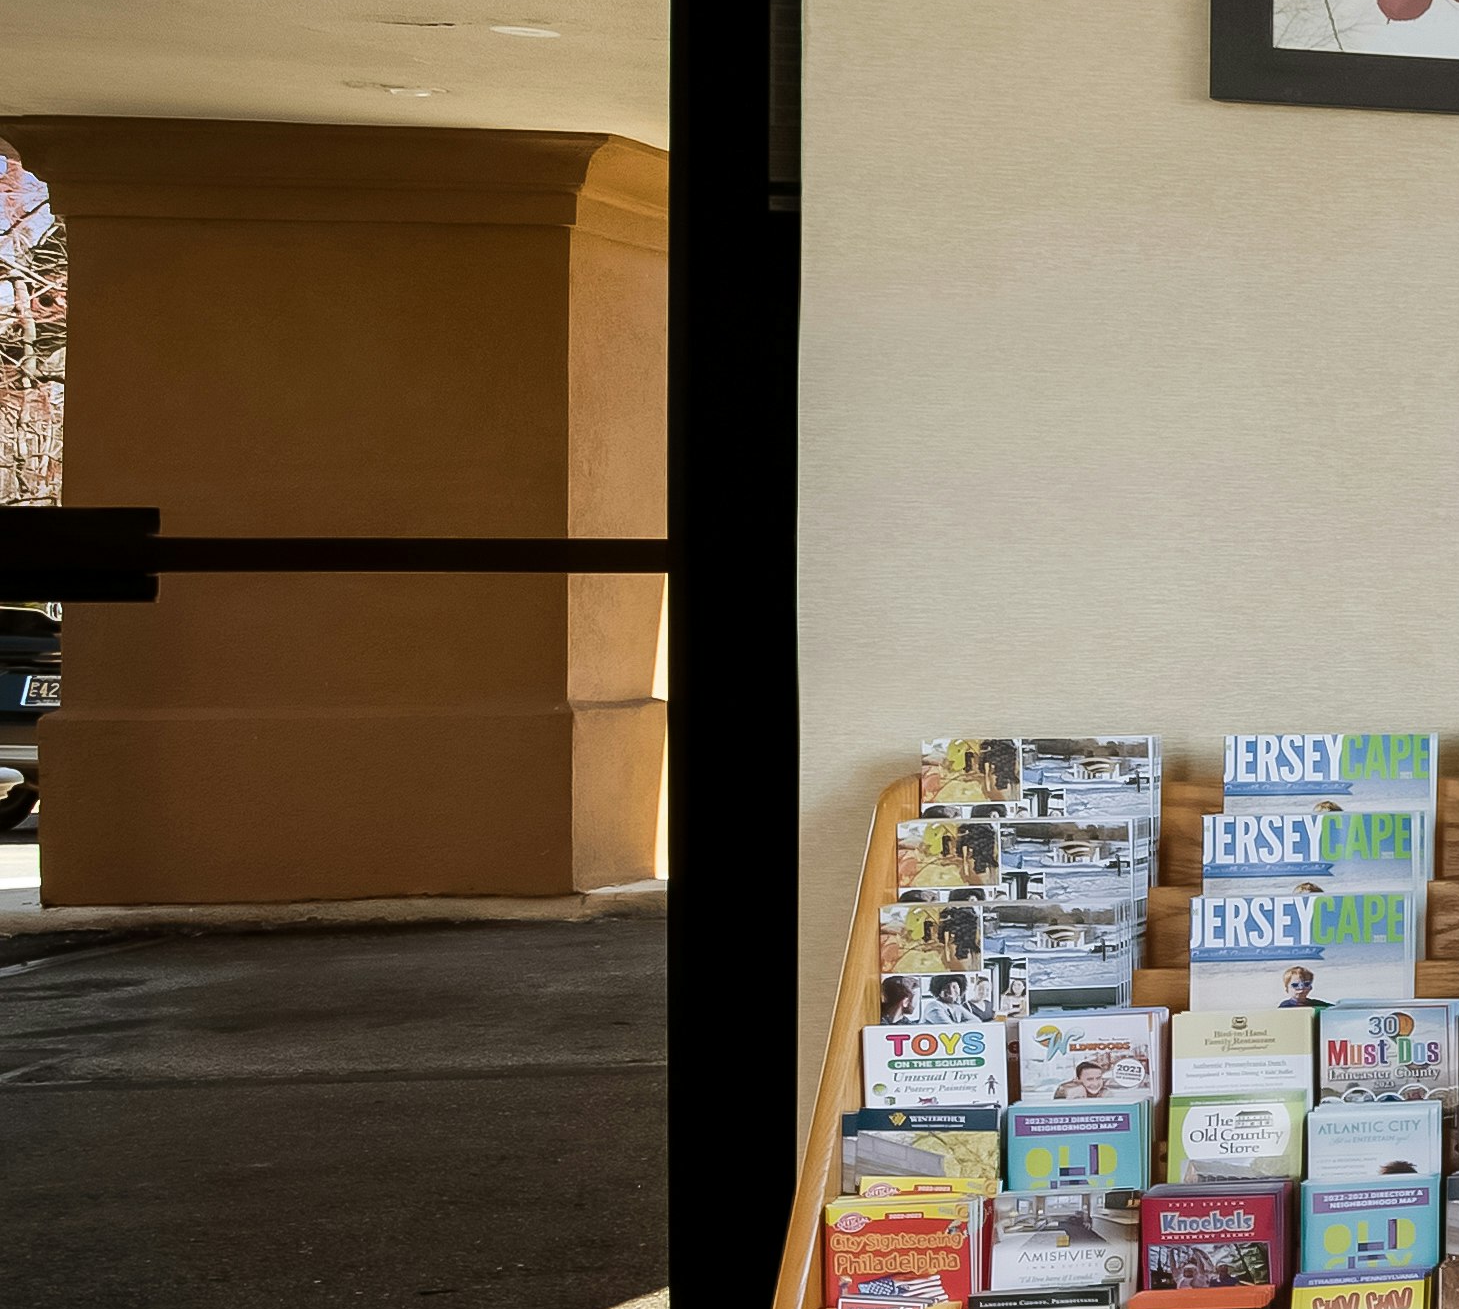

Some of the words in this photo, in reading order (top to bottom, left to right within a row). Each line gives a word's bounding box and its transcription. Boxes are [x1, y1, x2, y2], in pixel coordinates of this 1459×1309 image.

[1368, 1015, 1398, 1036] 30
[886, 1031, 986, 1057] TOYS
[913, 1060, 933, 1068] THE
[935, 1058, 977, 1067] SQUARE
[1117, 1064, 1142, 1074] 2023
[893, 1071, 947, 1083] Unusual
[953, 1071, 979, 1083] Toys
[1329, 1070, 1390, 1081] Lancaster
[1394, 1067, 1441, 1080] County
[1204, 1112, 1233, 1127] The
[1318, 1121, 1385, 1135] ATLANTIC
[1388, 1119, 1421, 1132] CITY
[1189, 1128, 1218, 1143] Old
[1220, 1129, 1284, 1144] Country
[1219, 1142, 1260, 1155] Store
[1160, 1209, 1255, 1234] Knoebels
[831, 1234, 863, 1252] City
[865, 1232, 964, 1250] Sightseeing
[834, 1251, 960, 1275] Philadelphia
[1018, 1249, 1107, 1263] AMISHVIEW
